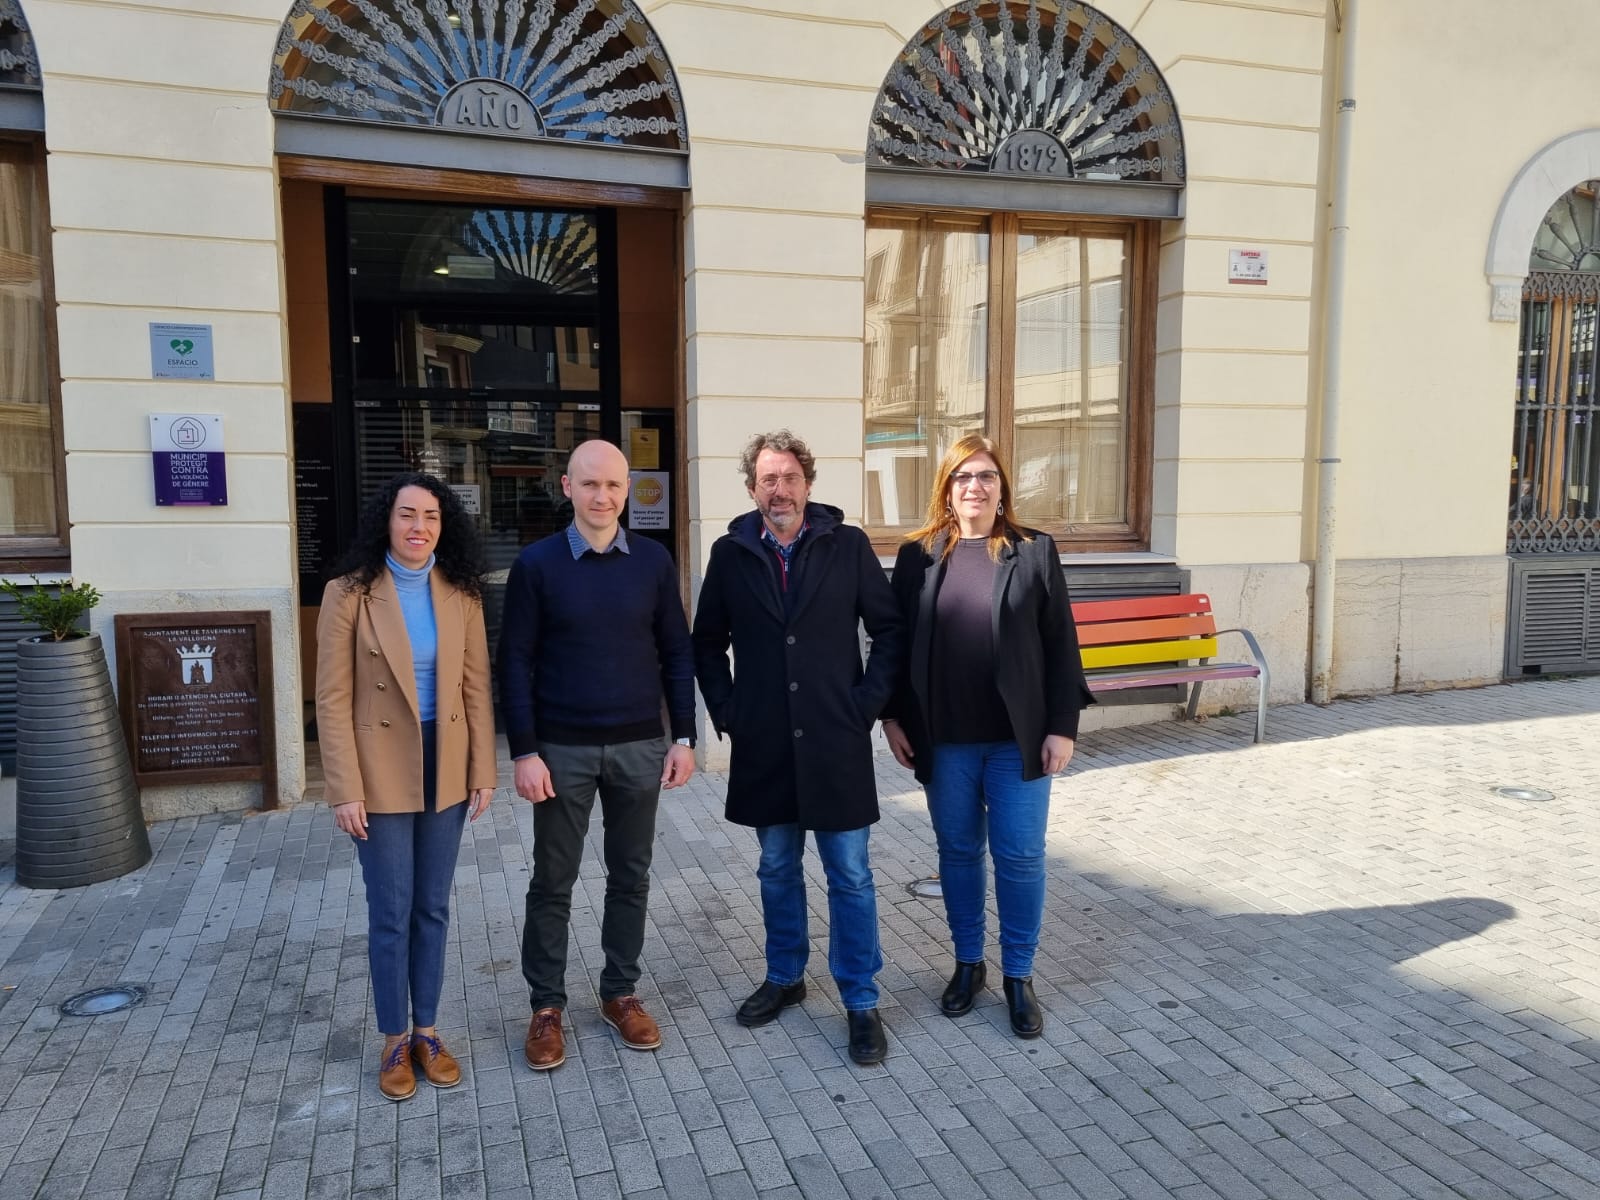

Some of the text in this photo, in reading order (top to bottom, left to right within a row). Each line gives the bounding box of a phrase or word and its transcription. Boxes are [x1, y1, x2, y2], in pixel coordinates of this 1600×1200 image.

[457, 87, 521, 130] AÑO
[1005, 143, 1057, 173] 1879
[171, 466, 209, 474] CONTRA
[636, 488, 660, 497] STOP
